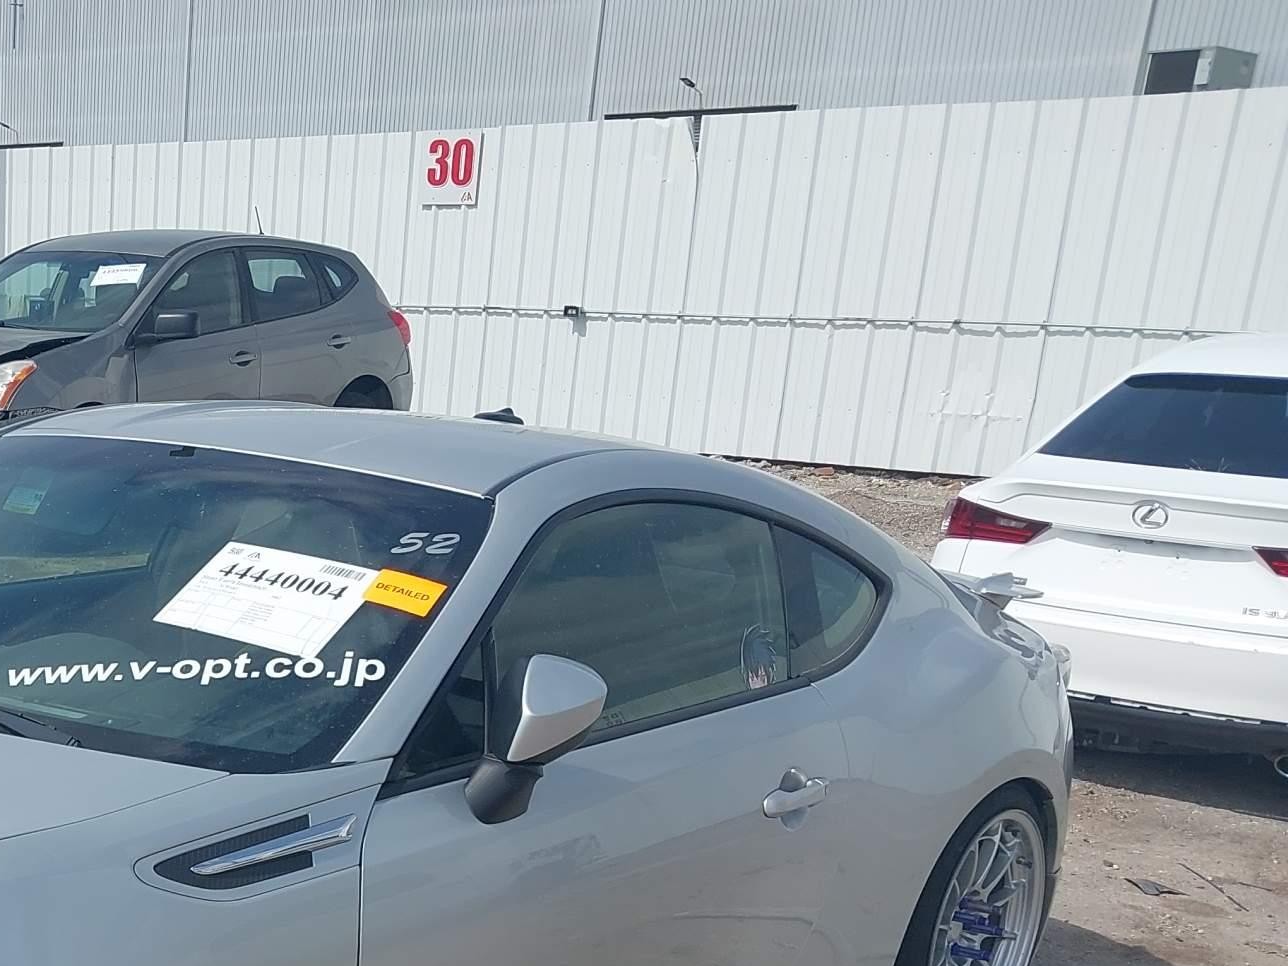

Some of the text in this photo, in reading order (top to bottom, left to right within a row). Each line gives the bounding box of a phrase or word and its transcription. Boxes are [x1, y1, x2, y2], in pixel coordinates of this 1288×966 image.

[427, 138, 474, 187] 30
[390, 532, 460, 554] 52
[219, 563, 349, 600] 44440004
[376, 582, 431, 601] DETAILED
[8, 650, 386, 687] www.v-opt.co.jp
